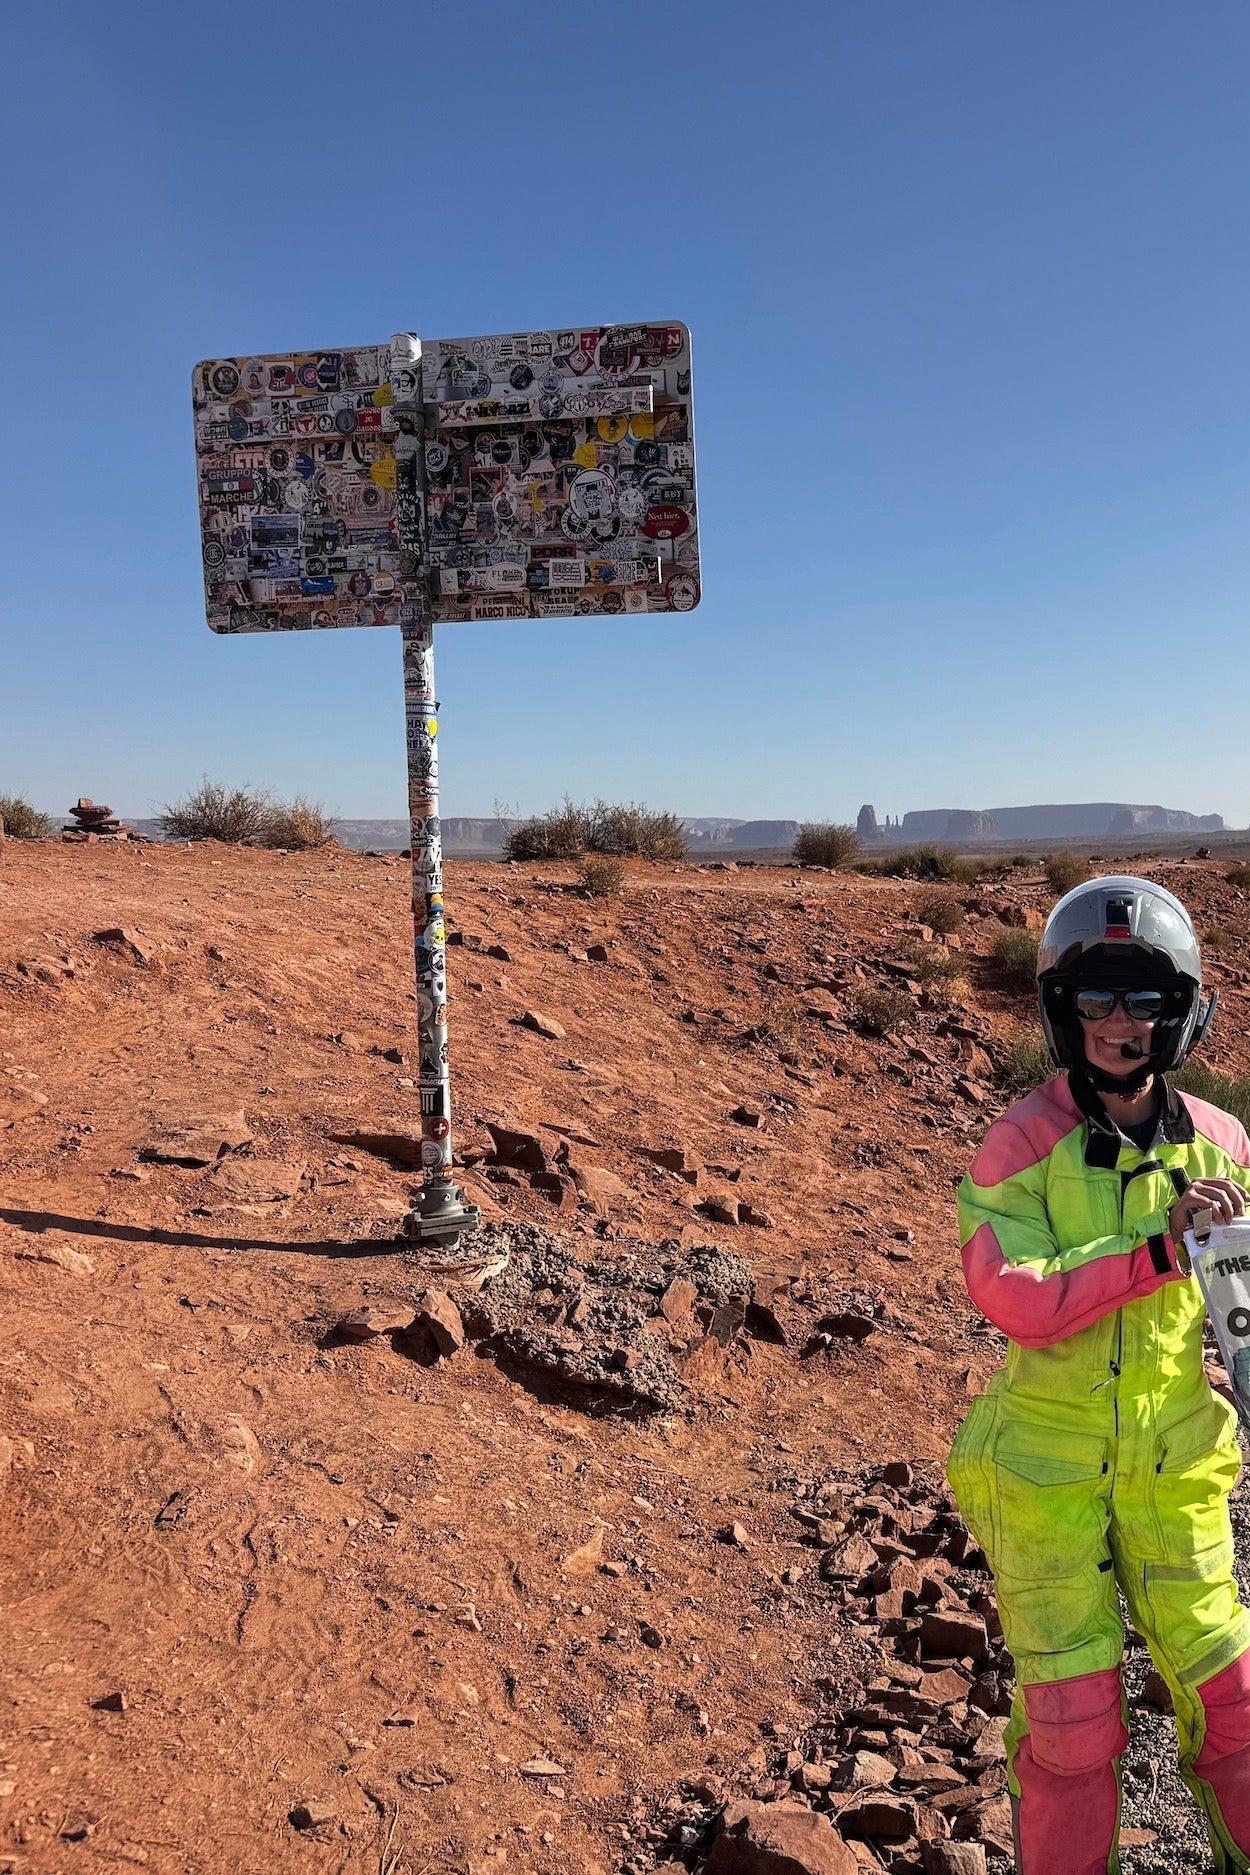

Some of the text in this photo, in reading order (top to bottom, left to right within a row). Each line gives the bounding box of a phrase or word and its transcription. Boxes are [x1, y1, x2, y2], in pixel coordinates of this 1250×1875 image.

[208, 468, 251, 480] GRUPPO
[210, 491, 254, 505] MARCHE
[475, 606, 504, 618] MARCO
[506, 605, 526, 617] NICO
